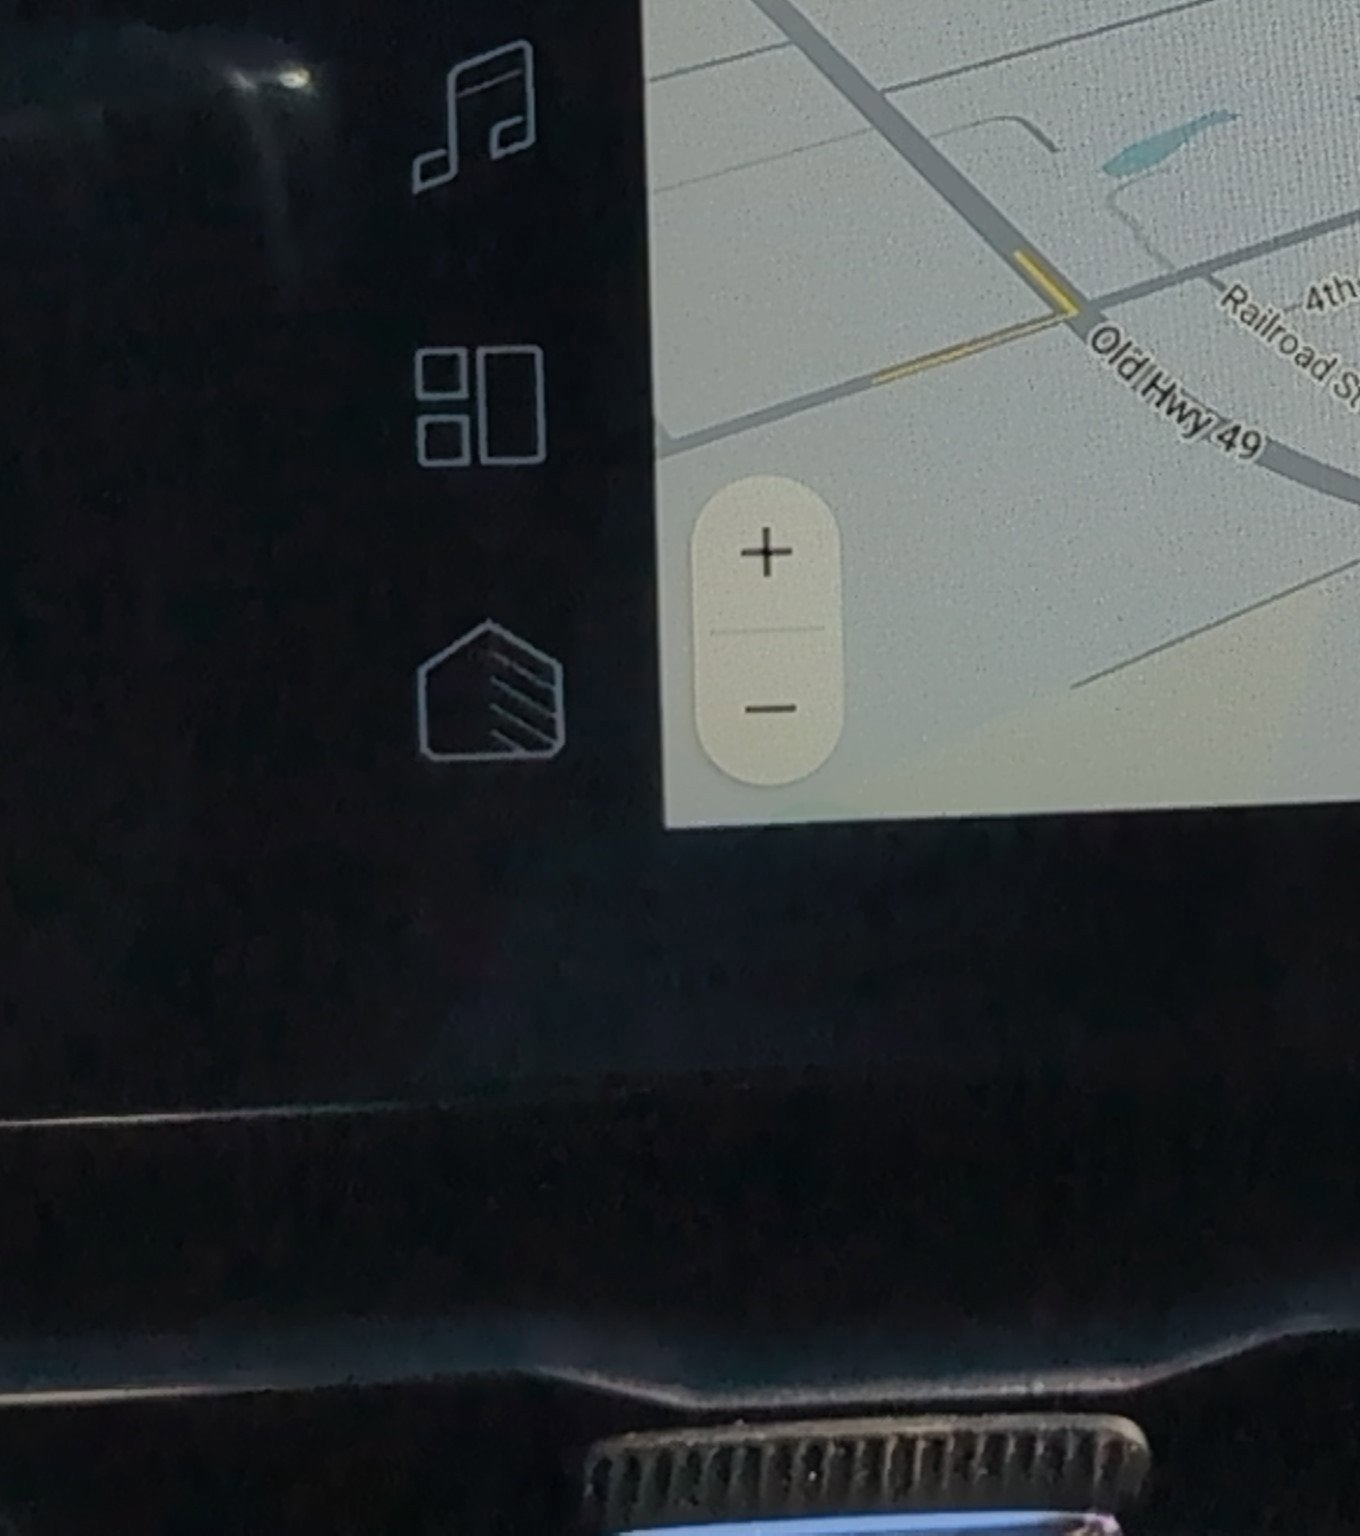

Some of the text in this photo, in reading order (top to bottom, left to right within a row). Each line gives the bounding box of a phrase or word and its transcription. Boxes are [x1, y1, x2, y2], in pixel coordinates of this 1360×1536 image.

[1220, 282, 1339, 383] Railroad
[1304, 281, 1360, 314] 4th
[1090, 325, 1262, 461] Old Hwy 49
